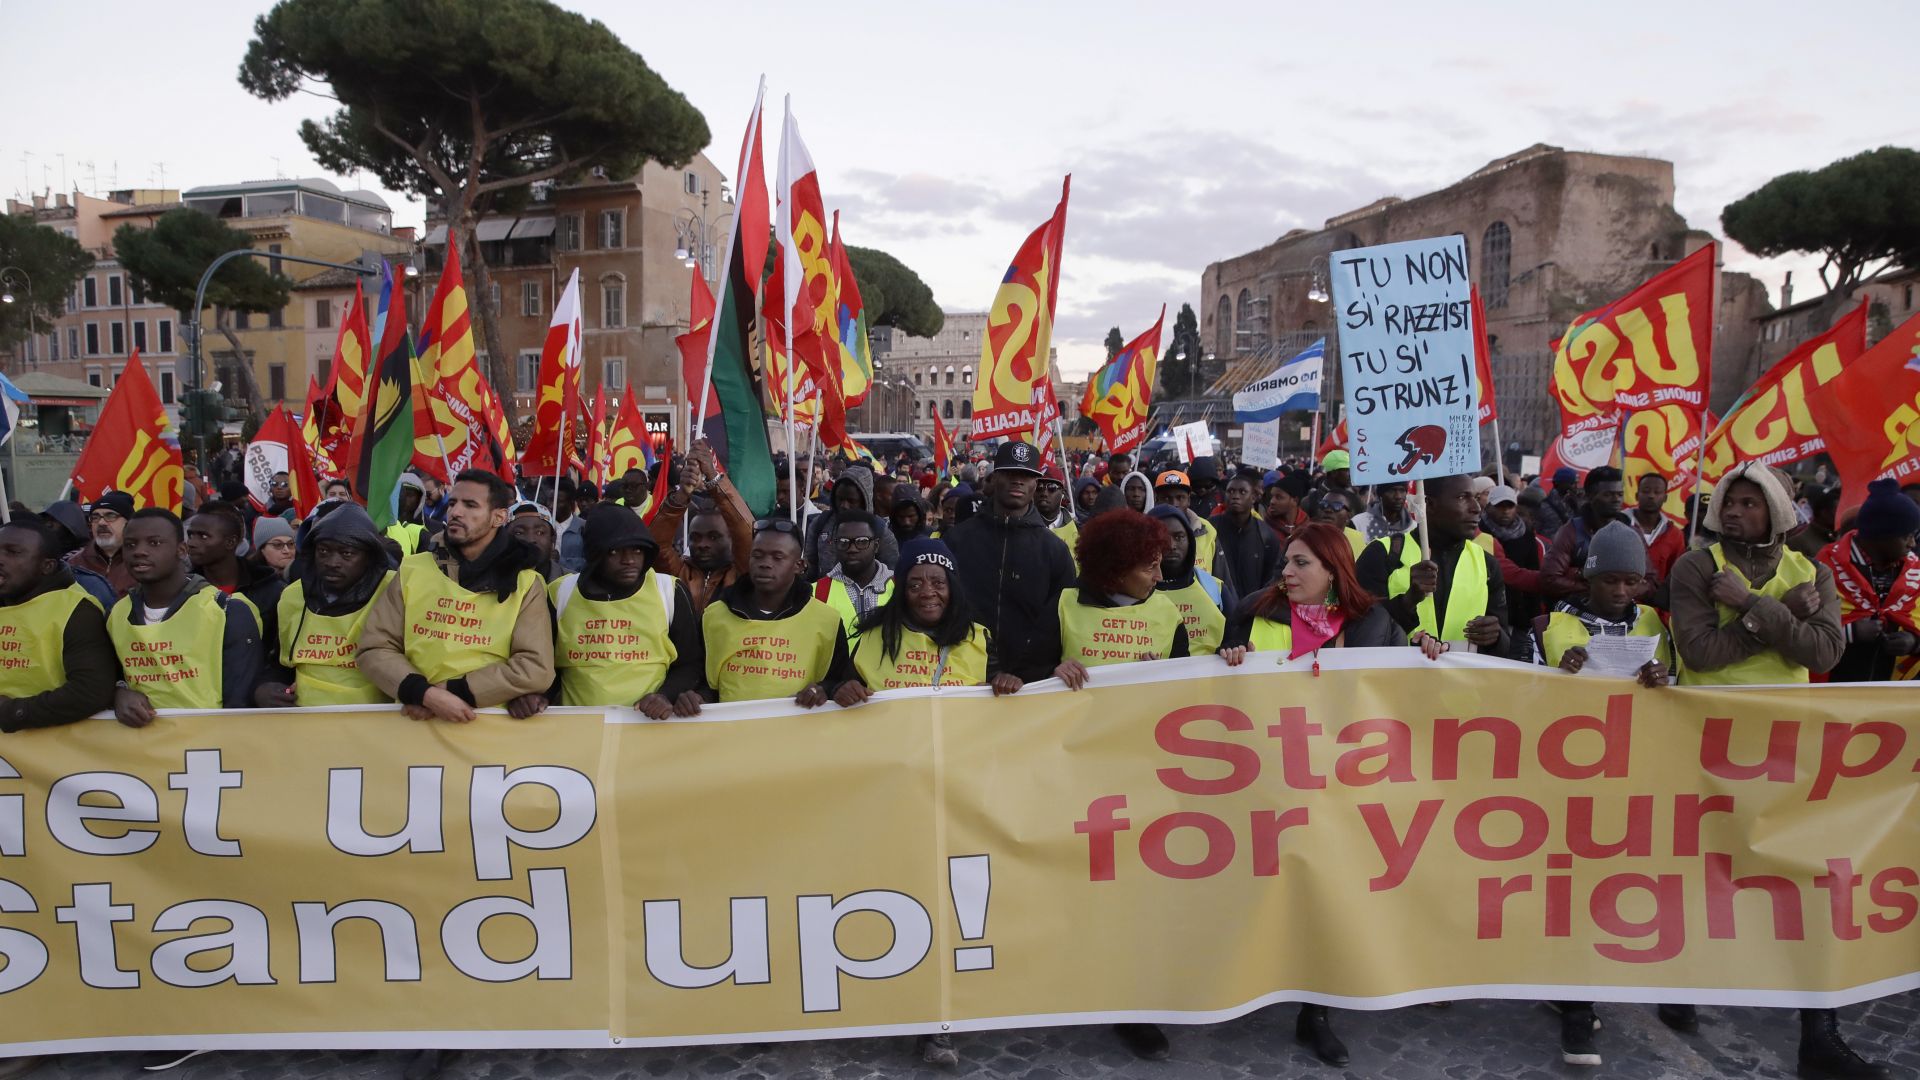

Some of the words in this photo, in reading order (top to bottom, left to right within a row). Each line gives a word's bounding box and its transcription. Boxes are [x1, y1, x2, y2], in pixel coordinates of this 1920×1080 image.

[1340, 257, 1391, 288] TU
[1405, 244, 1467, 285] NON
[1384, 290, 1471, 335] RAZZIST
[1348, 348, 1388, 374] TU
[646, 422, 668, 432] BAR
[455, 601, 476, 613] UP!
[460, 617, 482, 630] UP!
[585, 619, 607, 630] GET
[610, 619, 631, 630] UP!
[1102, 619, 1126, 630] GET
[1130, 620, 1147, 631] UP!
[307, 634, 332, 645] GET
[413, 623, 429, 636] for
[454, 633, 492, 646] right!
[578, 634, 614, 645] STAND
[618, 635, 639, 645] UP!
[1093, 632, 1133, 644] STAND
[1137, 635, 1152, 646] UP!
[2, 641, 21, 652] UP!
[148, 641, 173, 652] UP!
[743, 637, 767, 646] GET
[770, 637, 789, 648] UP!
[568, 650, 584, 660] for
[585, 652, 611, 661] your
[615, 650, 648, 661] right!
[736, 649, 772, 660] STAND
[776, 652, 797, 663] UP!
[905, 651, 927, 660] GET
[1081, 647, 1099, 657] for
[1102, 650, 1130, 660] your
[160, 655, 184, 666] UP!
[727, 662, 741, 672] for
[743, 665, 768, 675] your
[772, 667, 806, 679] right!
[896, 664, 931, 675] STAN
[1154, 693, 1633, 796] Stand
[0, 748, 243, 857] et
[326, 764, 598, 880] up
[1074, 795, 1309, 882] for
[1357, 793, 1735, 893] your
[643, 853, 994, 1014] up!
